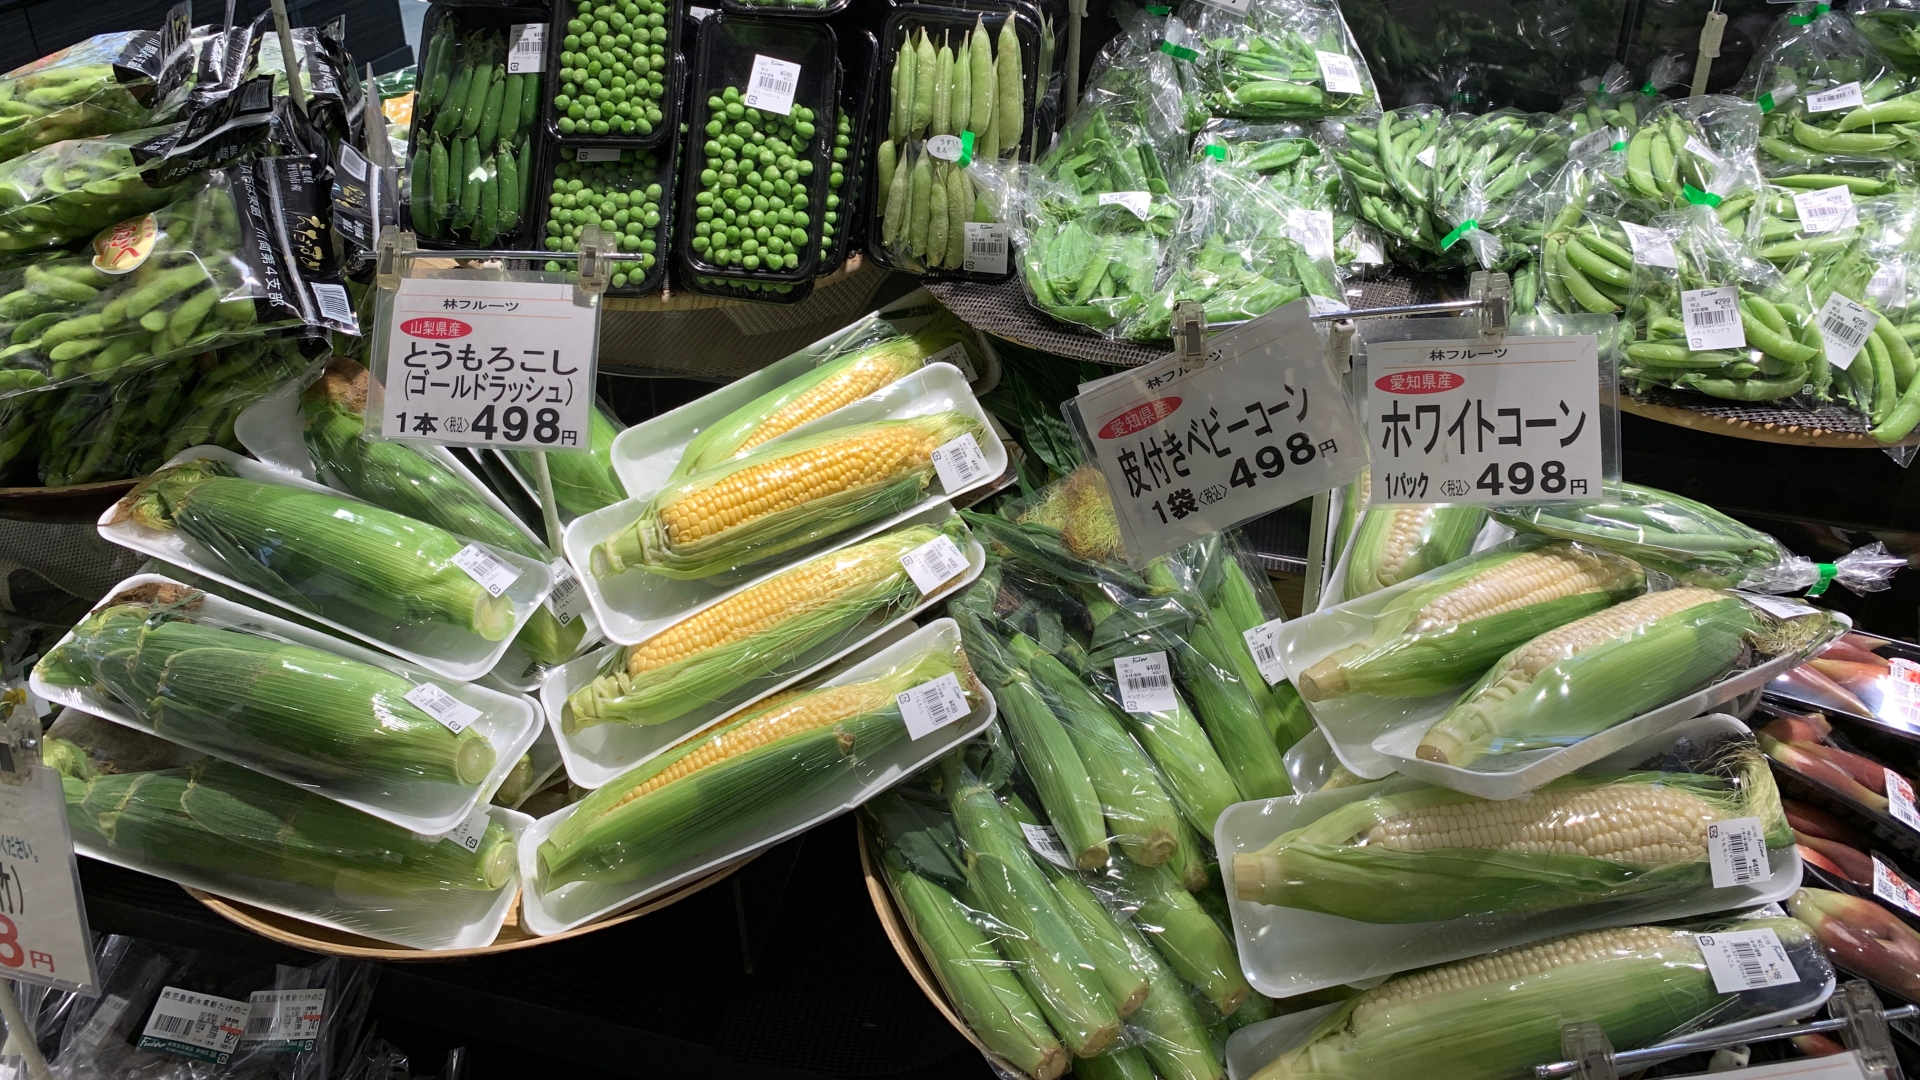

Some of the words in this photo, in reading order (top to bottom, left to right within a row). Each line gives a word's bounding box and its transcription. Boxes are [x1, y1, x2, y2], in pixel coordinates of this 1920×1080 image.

[940, 138, 959, 146] うすい
[443, 298, 519, 311] 林フルーツ
[410, 321, 461, 337] 山梨県産
[1852, 316, 1867, 327] ¥299
[403, 341, 578, 376] とうもろこし
[1429, 347, 1508, 361] 林フルーツ
[1146, 349, 1223, 390] 林フルツ
[1390, 373, 1453, 390] 愛知県産
[404, 370, 573, 406] (ゴールドラッシュ)
[1110, 400, 1171, 438] 愛知県産
[1381, 398, 1587, 457] ホワイトコーン
[1117, 383, 1308, 499] 皮付きベビーコーン
[1720, 832, 1729, 863] とうもろこし
[1751, 858, 1761, 876] ¥498
[1718, 940, 1734, 969] とうもろこし
